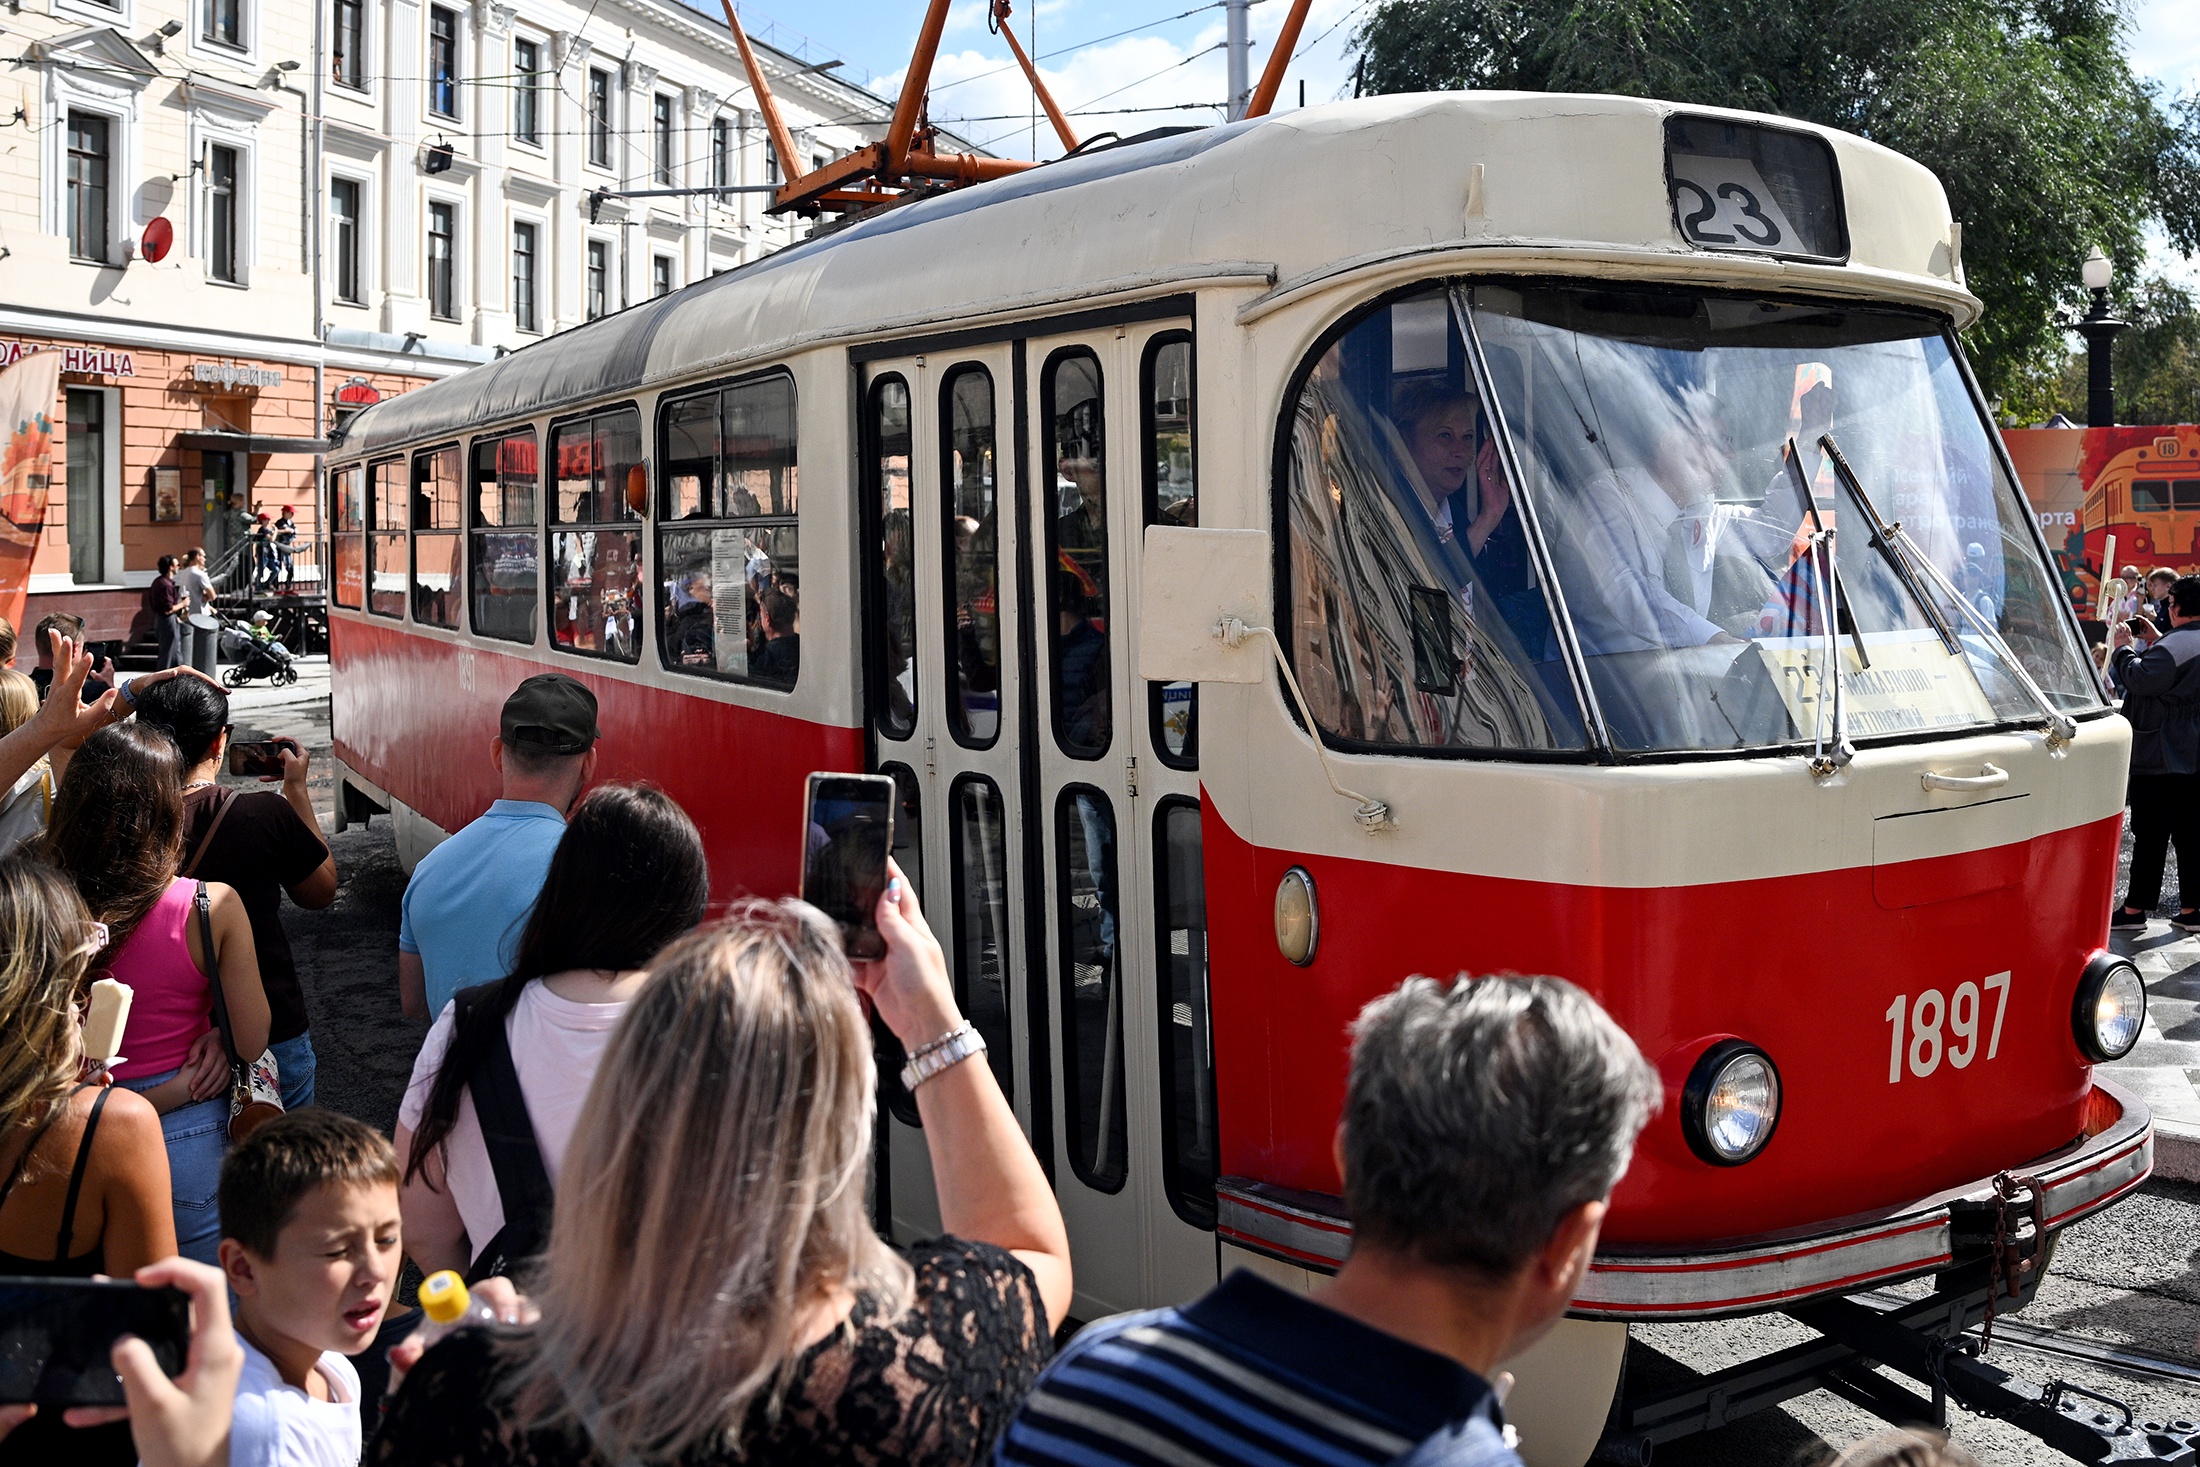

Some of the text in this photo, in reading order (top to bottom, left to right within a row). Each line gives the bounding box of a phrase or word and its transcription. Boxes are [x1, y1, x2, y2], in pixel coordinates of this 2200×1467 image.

[1675, 178, 1782, 246] 23
[0, 340, 135, 376] ЛНИЦА
[194, 359, 282, 391] кофейня
[2162, 442, 2175, 455] 18
[458, 652, 475, 692] 1897
[1783, 665, 1833, 704] 23
[1885, 970, 2011, 1084] 1897
